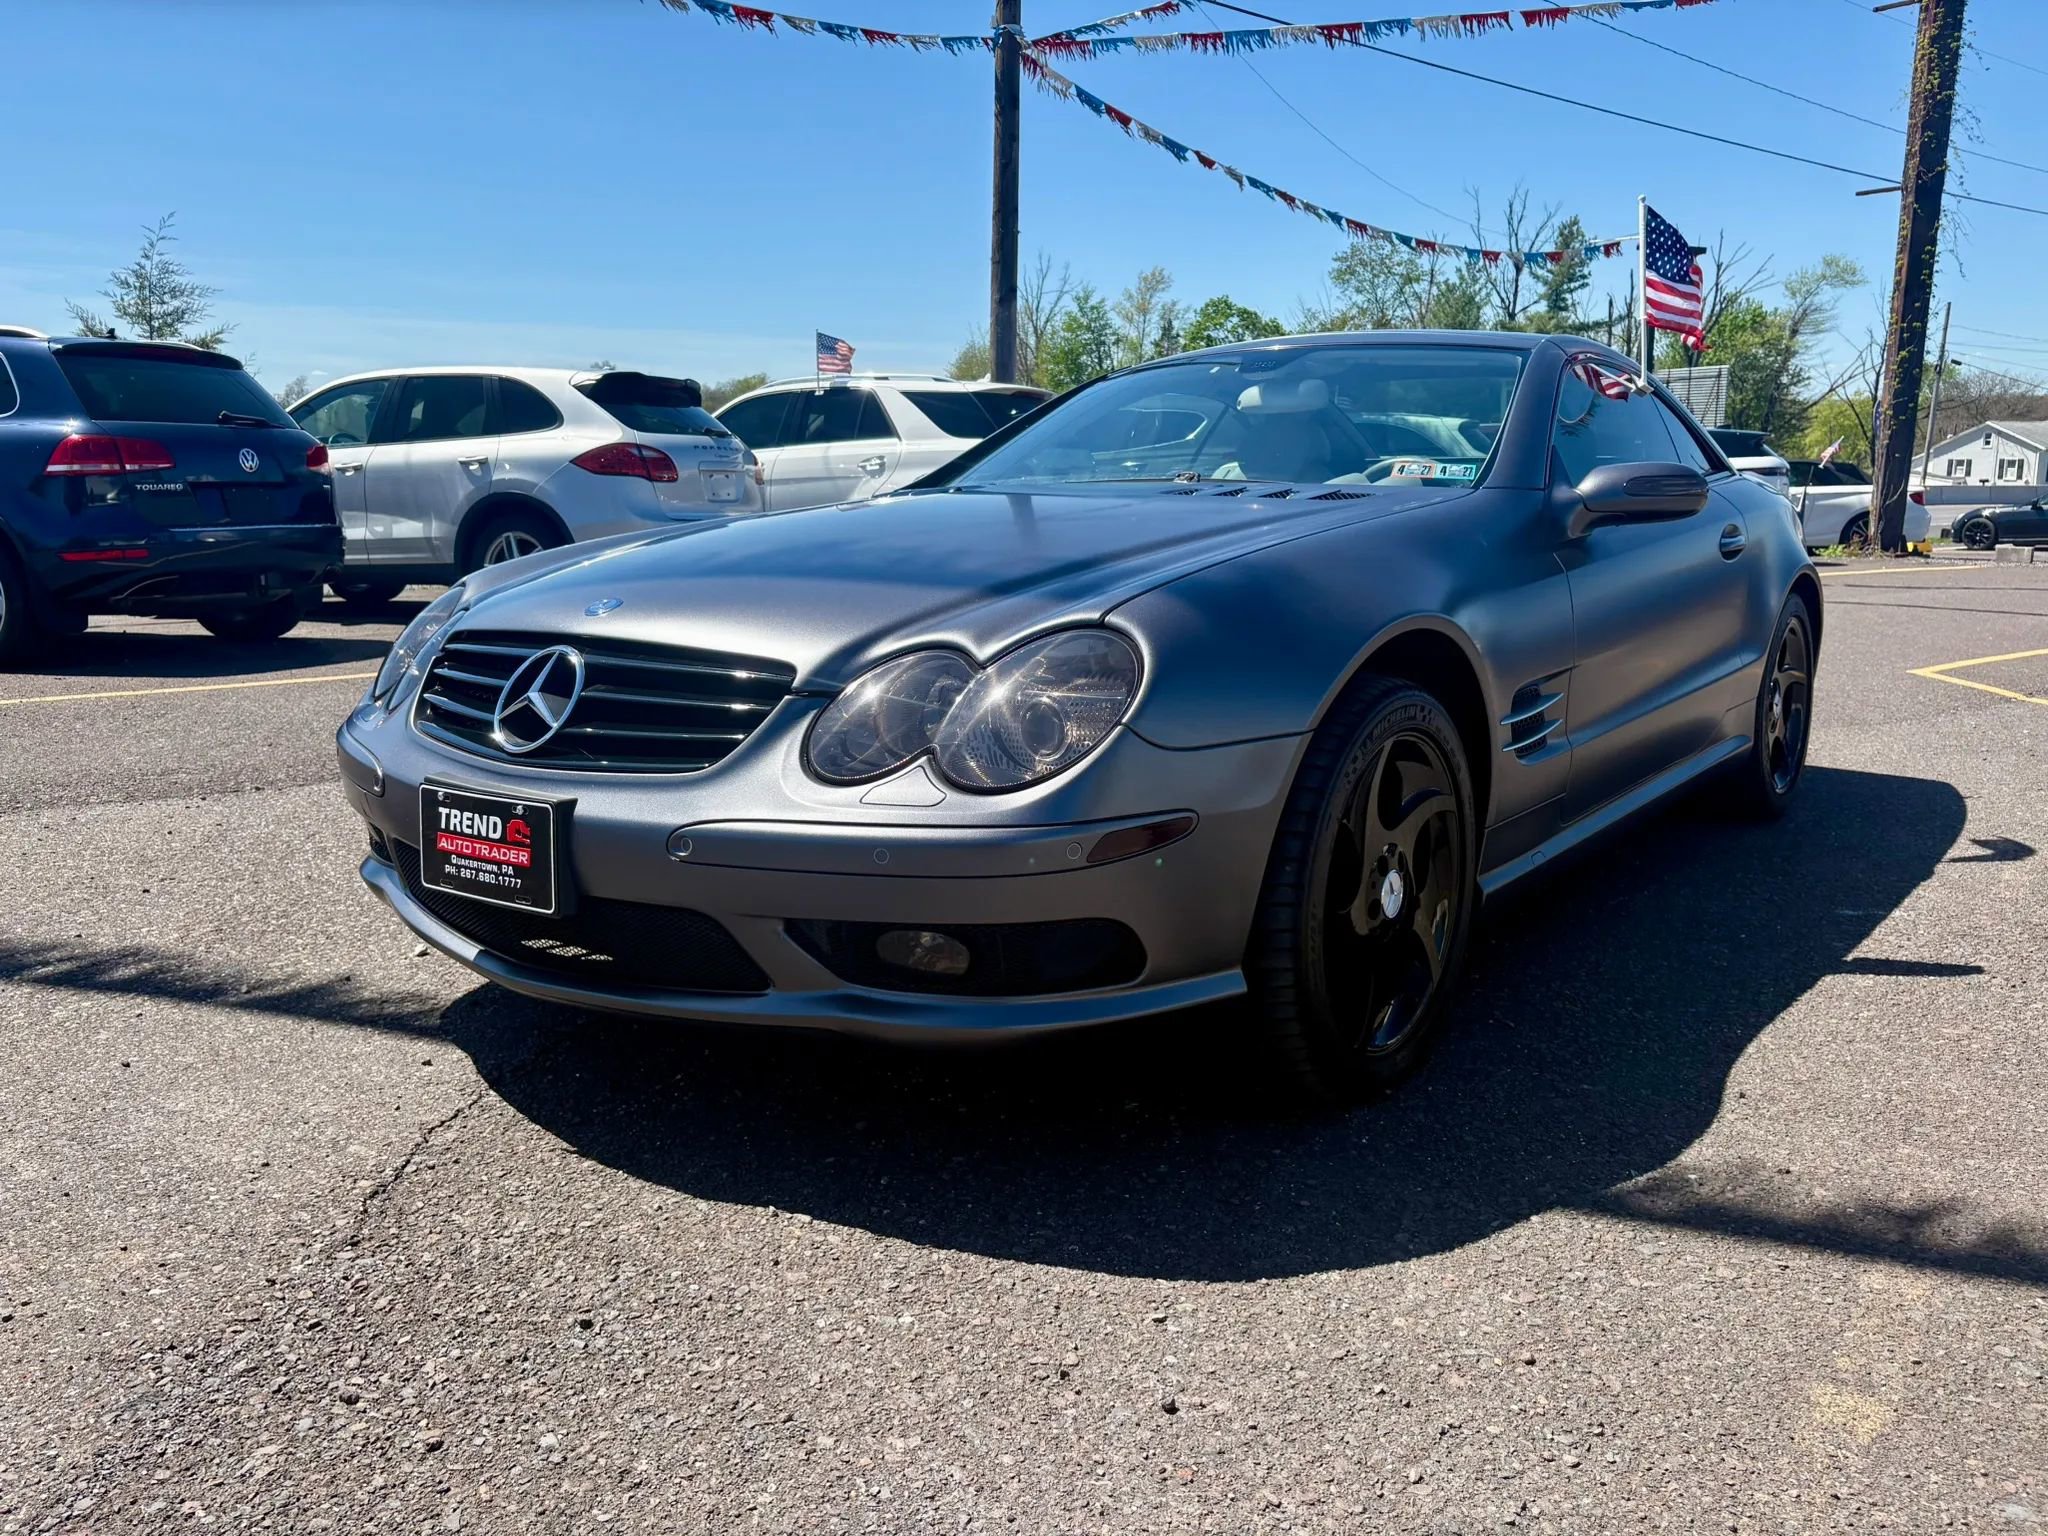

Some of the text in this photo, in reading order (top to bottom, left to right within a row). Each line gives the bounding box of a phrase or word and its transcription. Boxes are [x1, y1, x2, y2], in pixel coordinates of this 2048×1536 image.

[1397, 464, 1432, 476] 4 27
[1440, 466, 1474, 477] 4 27
[135, 483, 184, 492] TOUAREG
[438, 807, 502, 839] TREND
[439, 838, 528, 863] AUTO TRADER
[445, 865, 521, 888] PH: 267.680.1777
[502, 866, 514, 876] PA
